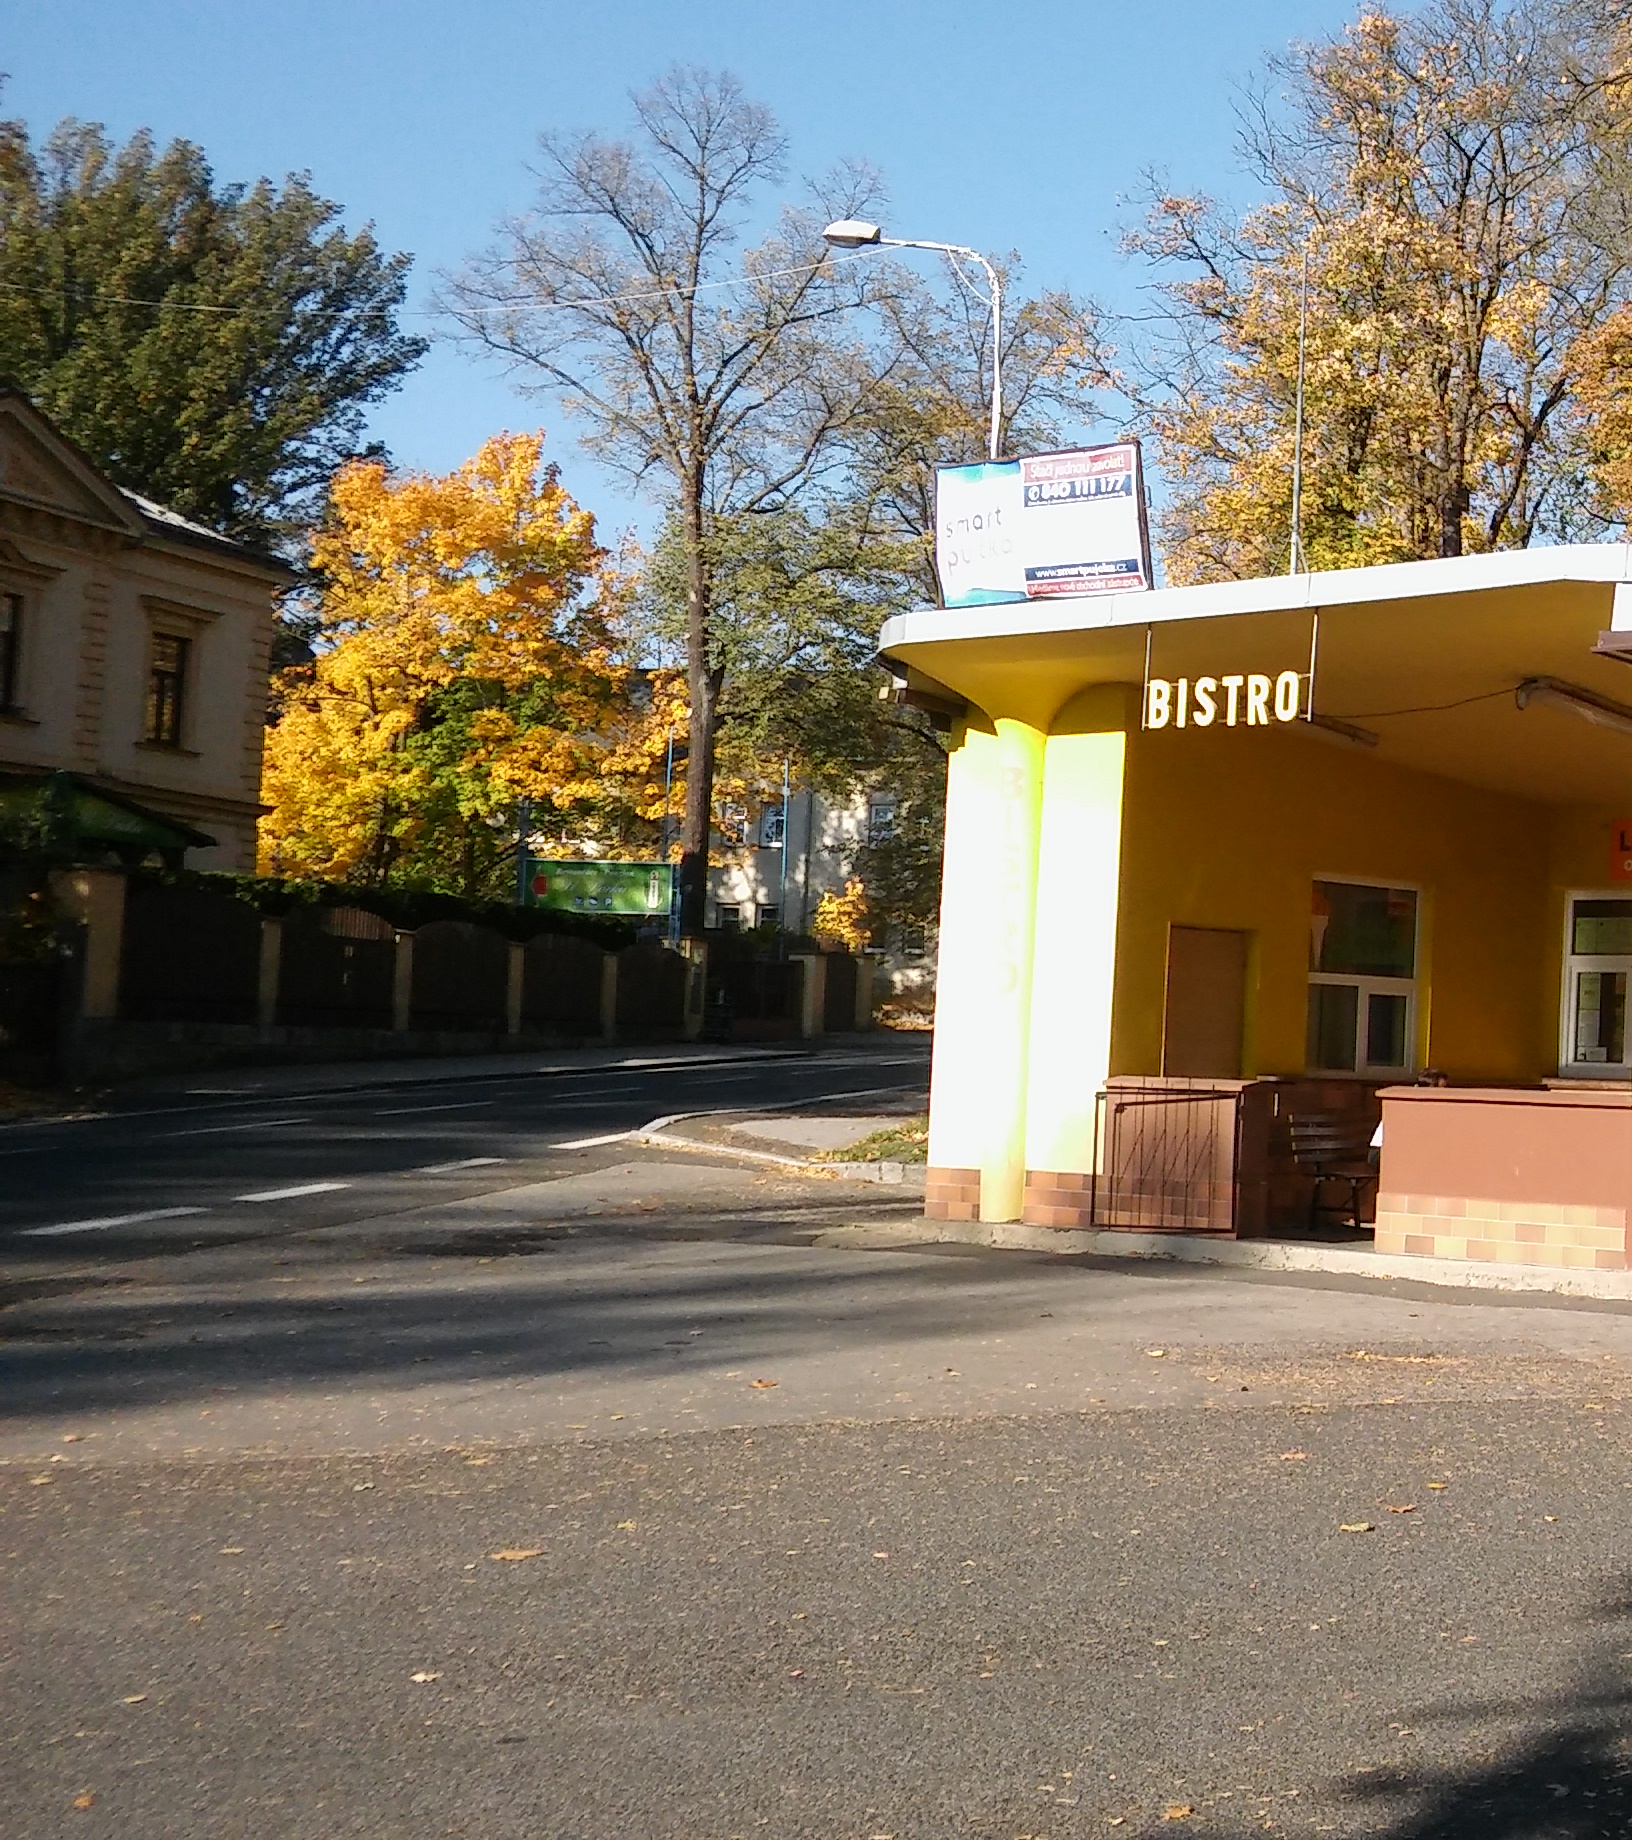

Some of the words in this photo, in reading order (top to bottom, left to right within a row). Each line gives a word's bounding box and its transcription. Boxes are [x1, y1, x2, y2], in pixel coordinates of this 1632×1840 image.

[1074, 479, 1096, 496] 111
[1099, 475, 1126, 493] 177
[945, 506, 1002, 538] smart
[1149, 670, 1300, 729] BISTRO
